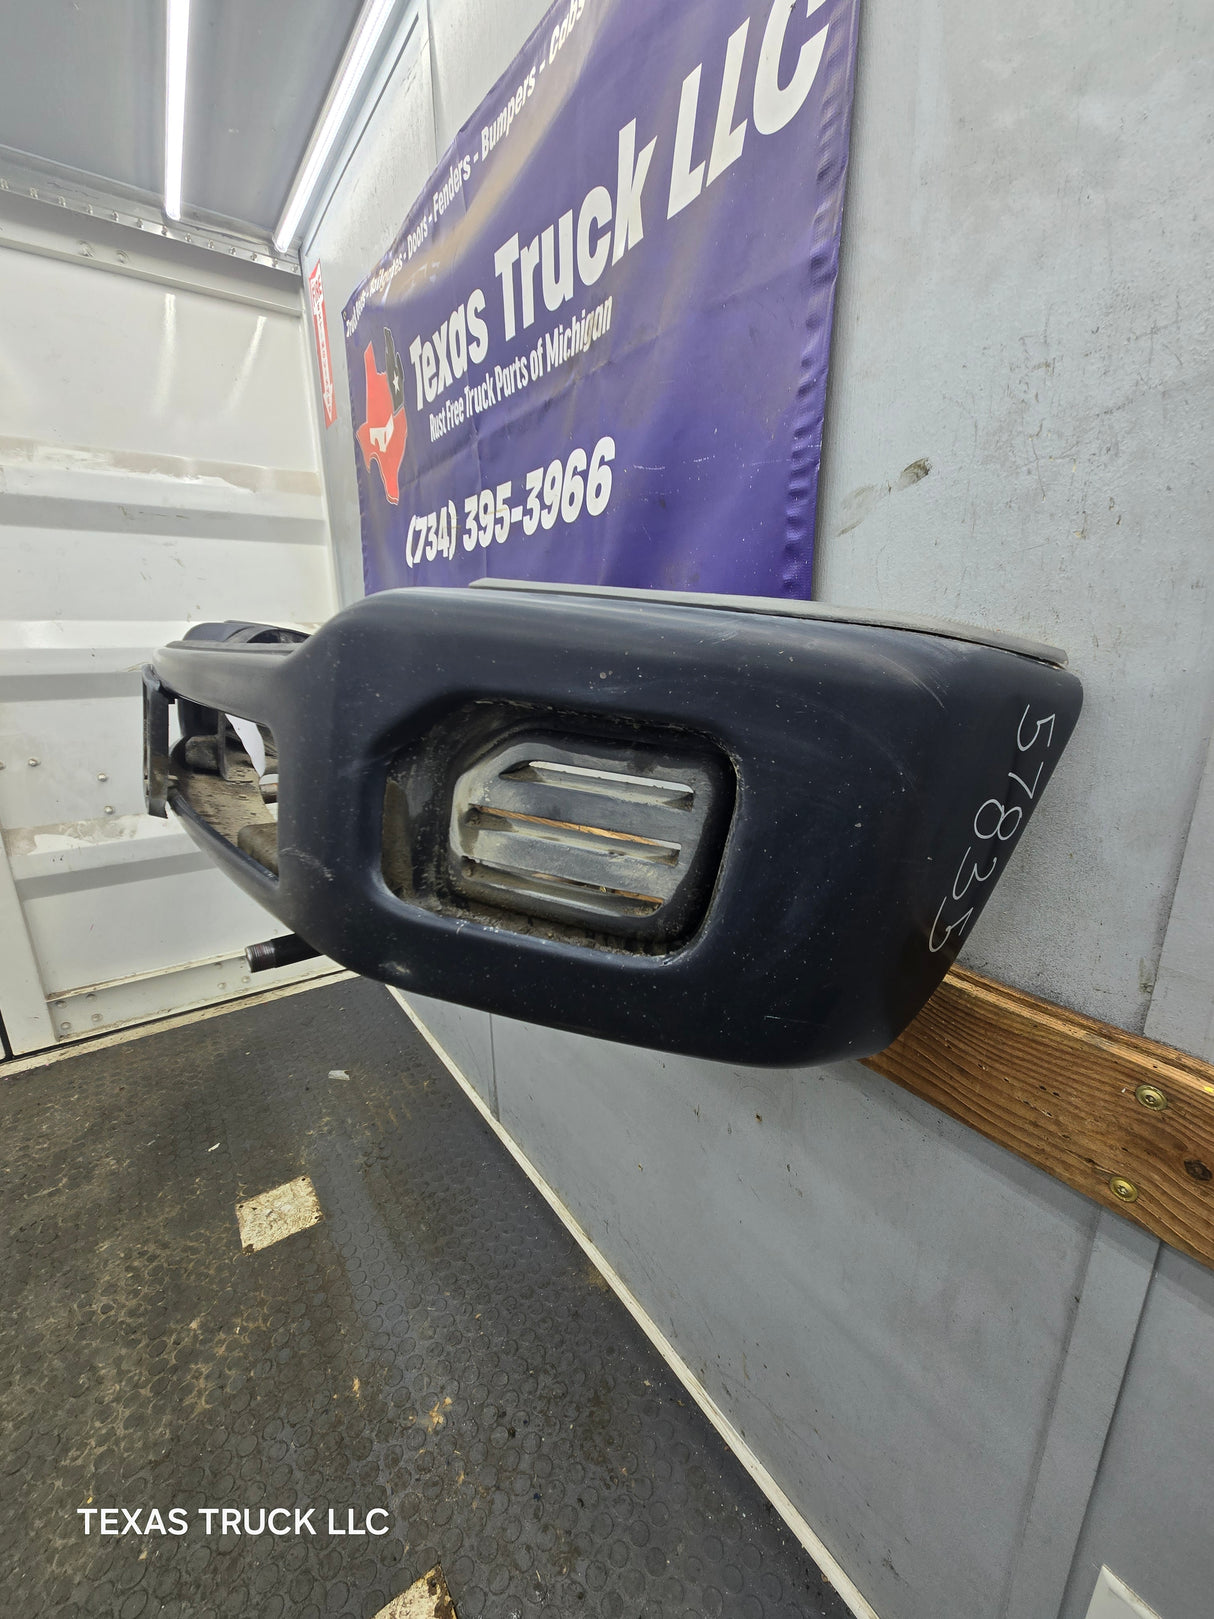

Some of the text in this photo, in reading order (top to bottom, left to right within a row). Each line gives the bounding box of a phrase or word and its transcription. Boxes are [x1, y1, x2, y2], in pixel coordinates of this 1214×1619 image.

[407, 215, 428, 260] Doors
[433, 154, 471, 223] Fenders
[480, 65, 537, 162] Bumpers
[409, 288, 489, 411] Texas
[494, 117, 658, 341] Truck
[666, 0, 829, 220] LLC
[429, 295, 613, 442] Rust Free Truck Parts of Michigan
[405, 436, 616, 568] (734) 395-3966
